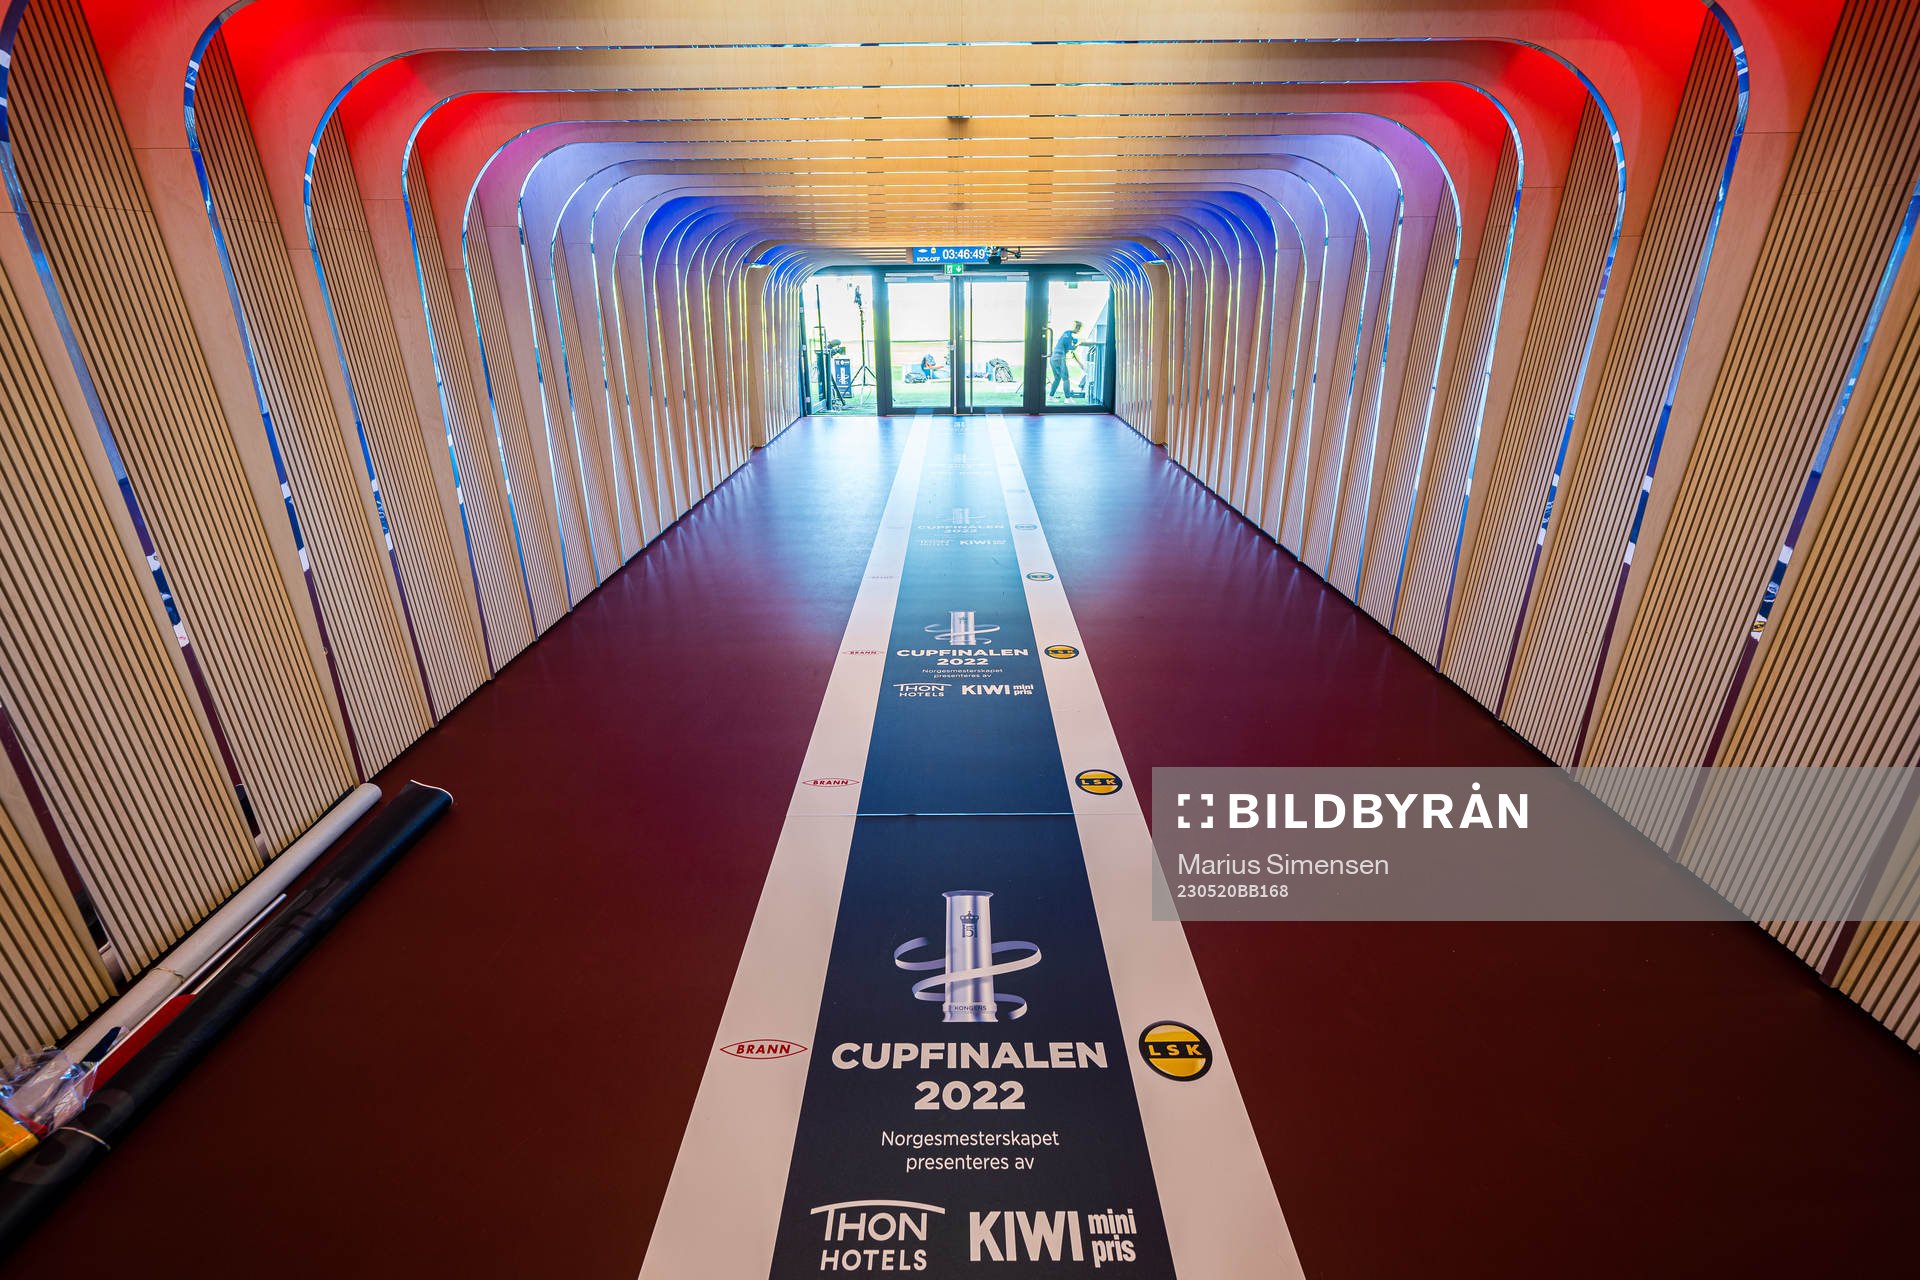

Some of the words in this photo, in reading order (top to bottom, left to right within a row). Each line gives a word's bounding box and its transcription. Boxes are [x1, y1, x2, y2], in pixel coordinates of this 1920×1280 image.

[942, 249, 985, 259] 03:46:49
[896, 648, 1029, 656] CUPFINALEN
[936, 657, 989, 666] 2022
[893, 682, 952, 692] THON
[962, 684, 1010, 695] KIWI
[812, 778, 849, 786] BRANN
[1080, 778, 1118, 787] LSK
[735, 1041, 791, 1056] BRANN
[831, 1041, 1108, 1070] CUPFINALEN
[1147, 1043, 1203, 1058] LSK
[914, 1080, 1027, 1111] 2022
[881, 1130, 1060, 1149] Norgesmesterskapet
[905, 1155, 1011, 1173] presenteres
[1014, 1157, 1035, 1170] av
[810, 1199, 946, 1241] THON
[1087, 1208, 1138, 1236] mini
[969, 1210, 1085, 1262] KIWI
[820, 1248, 928, 1271] HOTELS
[1091, 1234, 1137, 1269] pris
